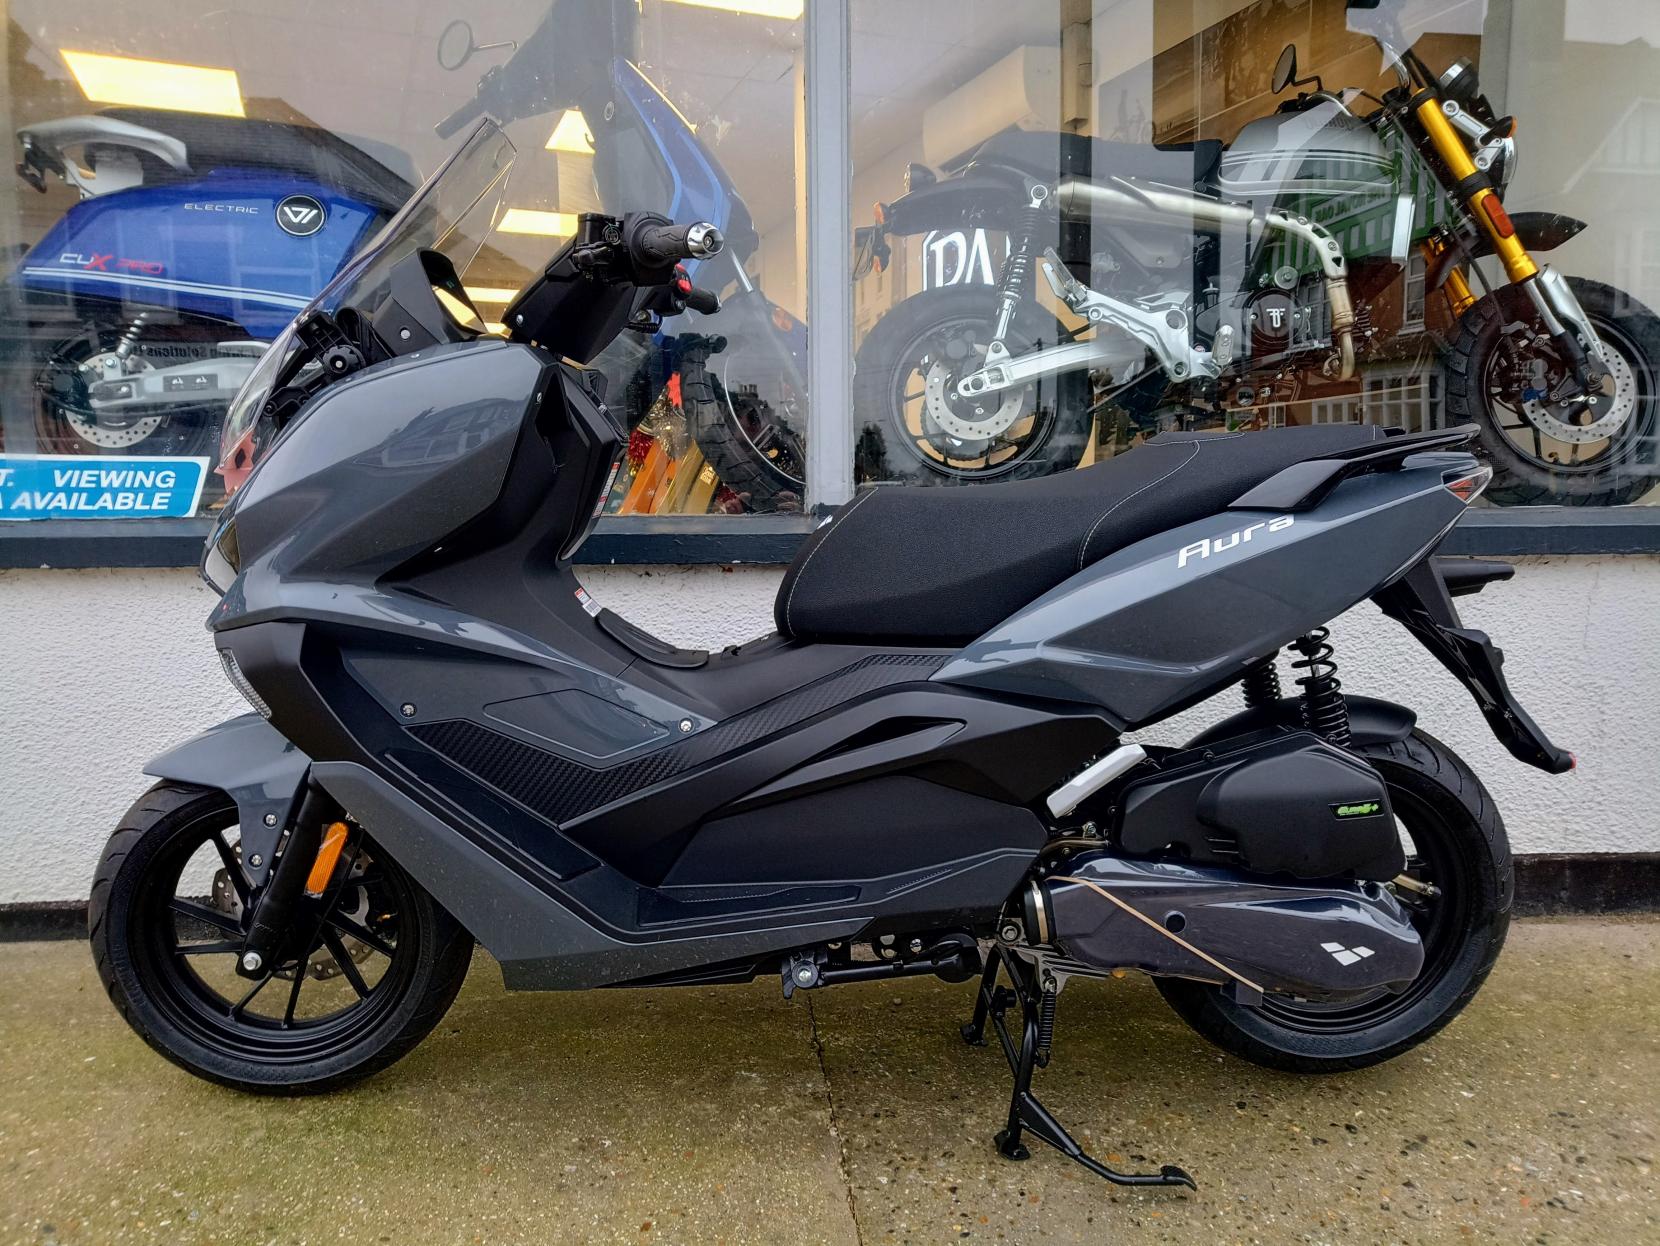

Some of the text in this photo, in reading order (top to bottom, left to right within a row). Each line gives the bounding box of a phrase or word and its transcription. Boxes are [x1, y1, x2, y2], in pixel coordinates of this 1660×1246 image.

[184, 203, 259, 215] ELECTRIC
[53, 470, 176, 488] VIEWING
[10, 491, 172, 511] AVAILABLE
[1178, 514, 1295, 569] Aura
